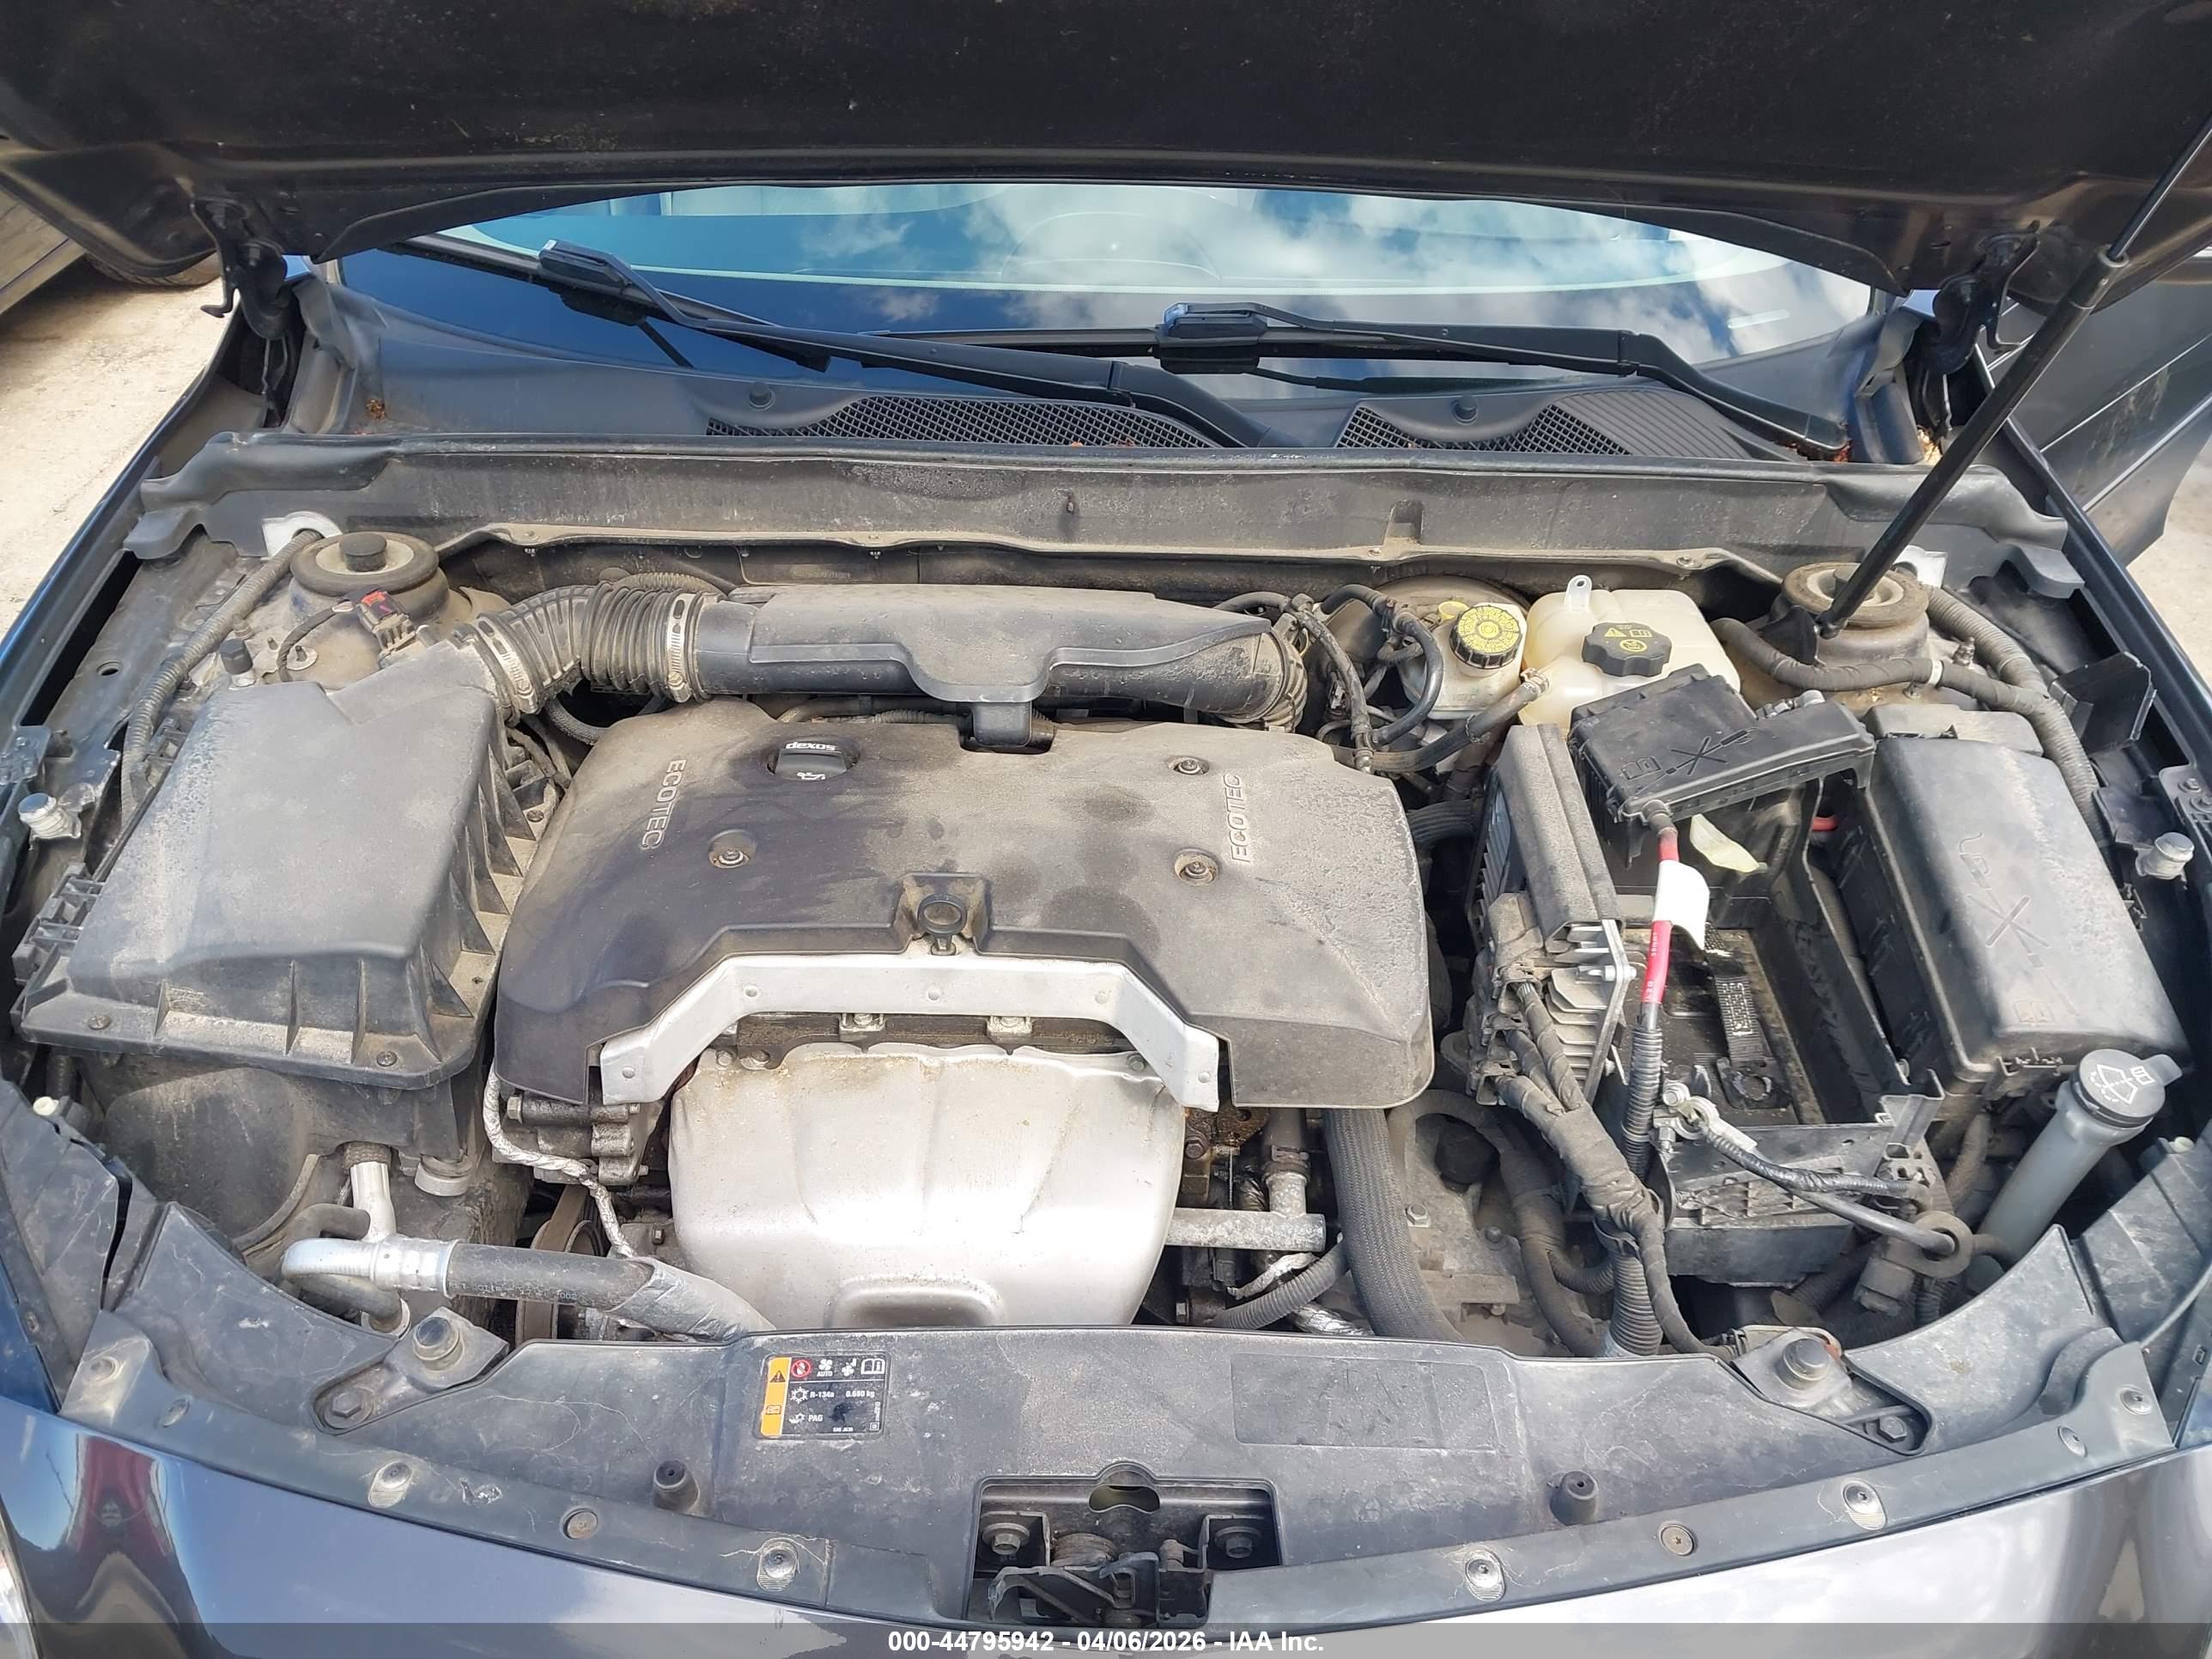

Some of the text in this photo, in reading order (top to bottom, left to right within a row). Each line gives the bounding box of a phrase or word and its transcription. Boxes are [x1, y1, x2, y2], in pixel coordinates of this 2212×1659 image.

[786, 741, 836, 751] dexos
[640, 759, 685, 849] ECOTEC
[1223, 774, 1250, 862] ECOTEC
